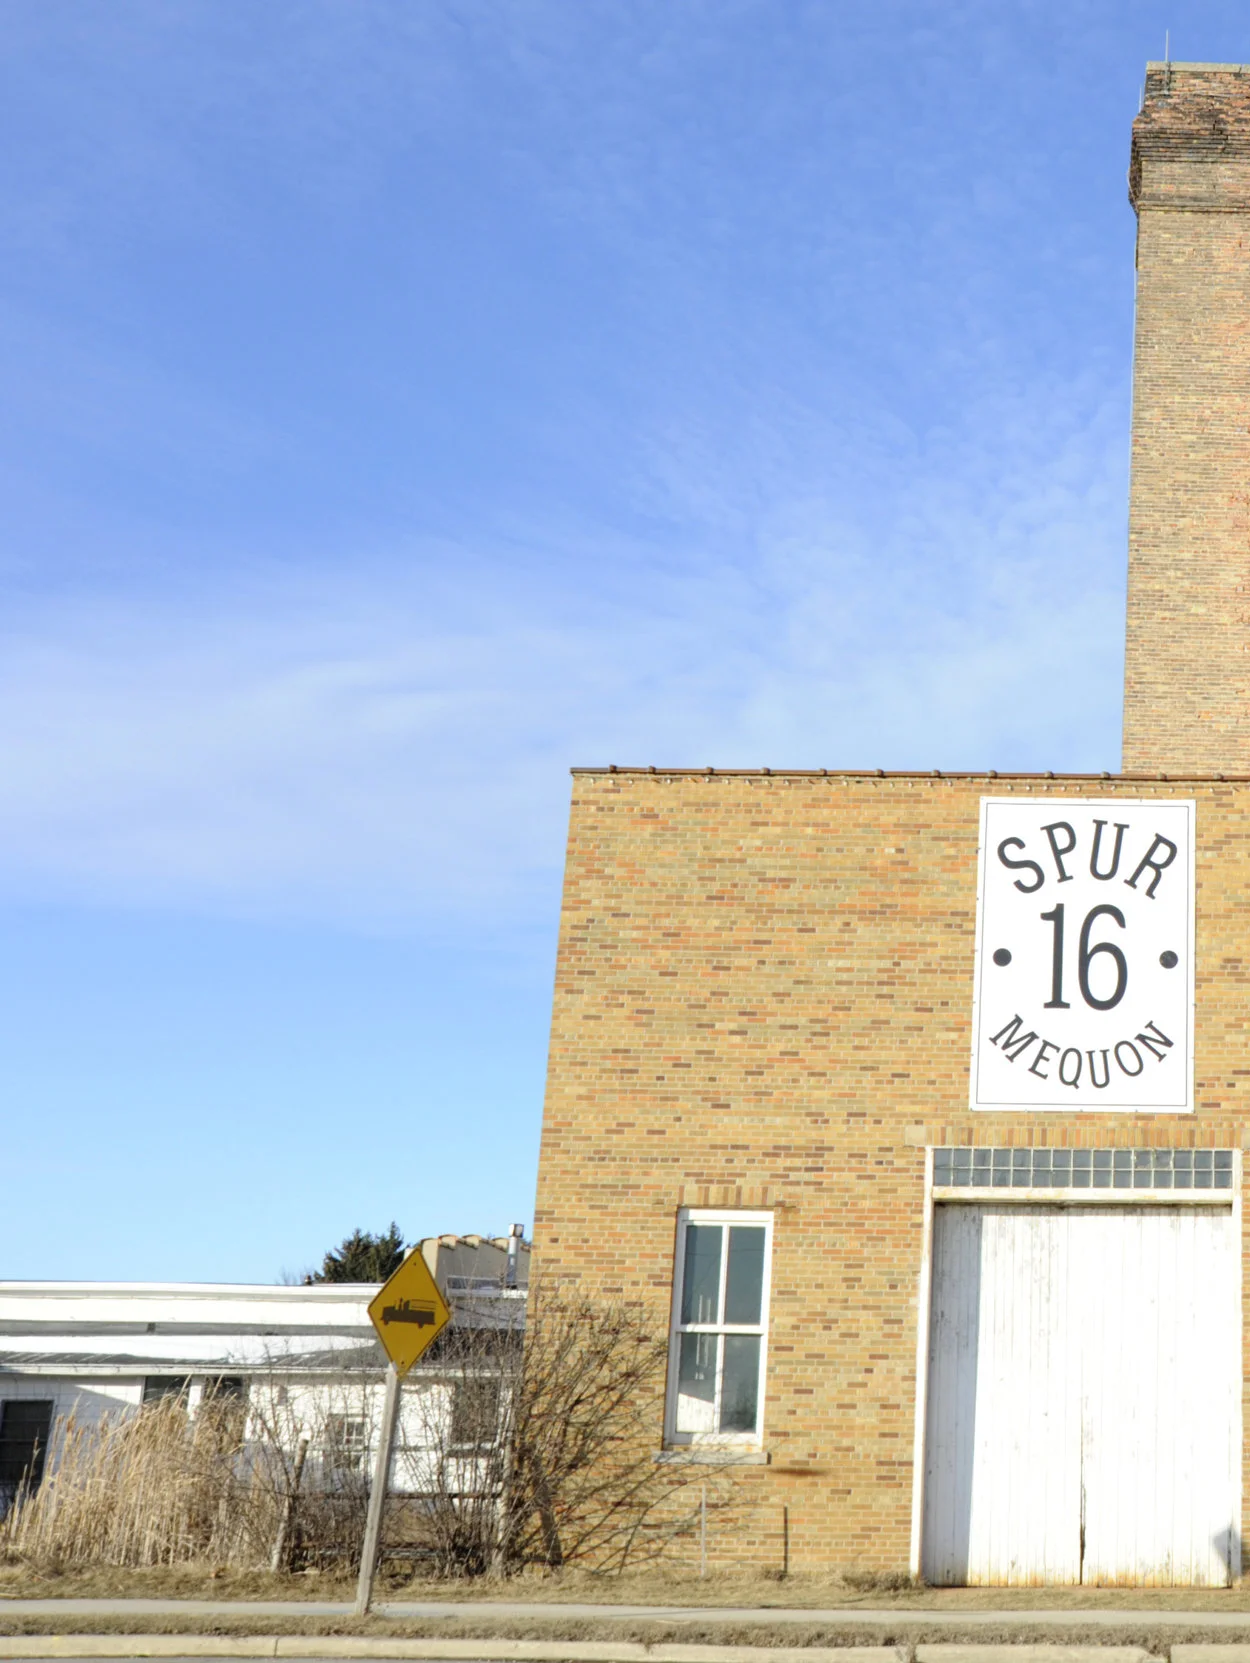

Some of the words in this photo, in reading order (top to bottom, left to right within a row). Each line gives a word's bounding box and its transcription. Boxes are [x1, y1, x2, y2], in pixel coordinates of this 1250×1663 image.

[997, 819, 1178, 900] SPUR
[1040, 903, 1128, 1011] 16
[989, 1014, 1174, 1089] MEQUON
